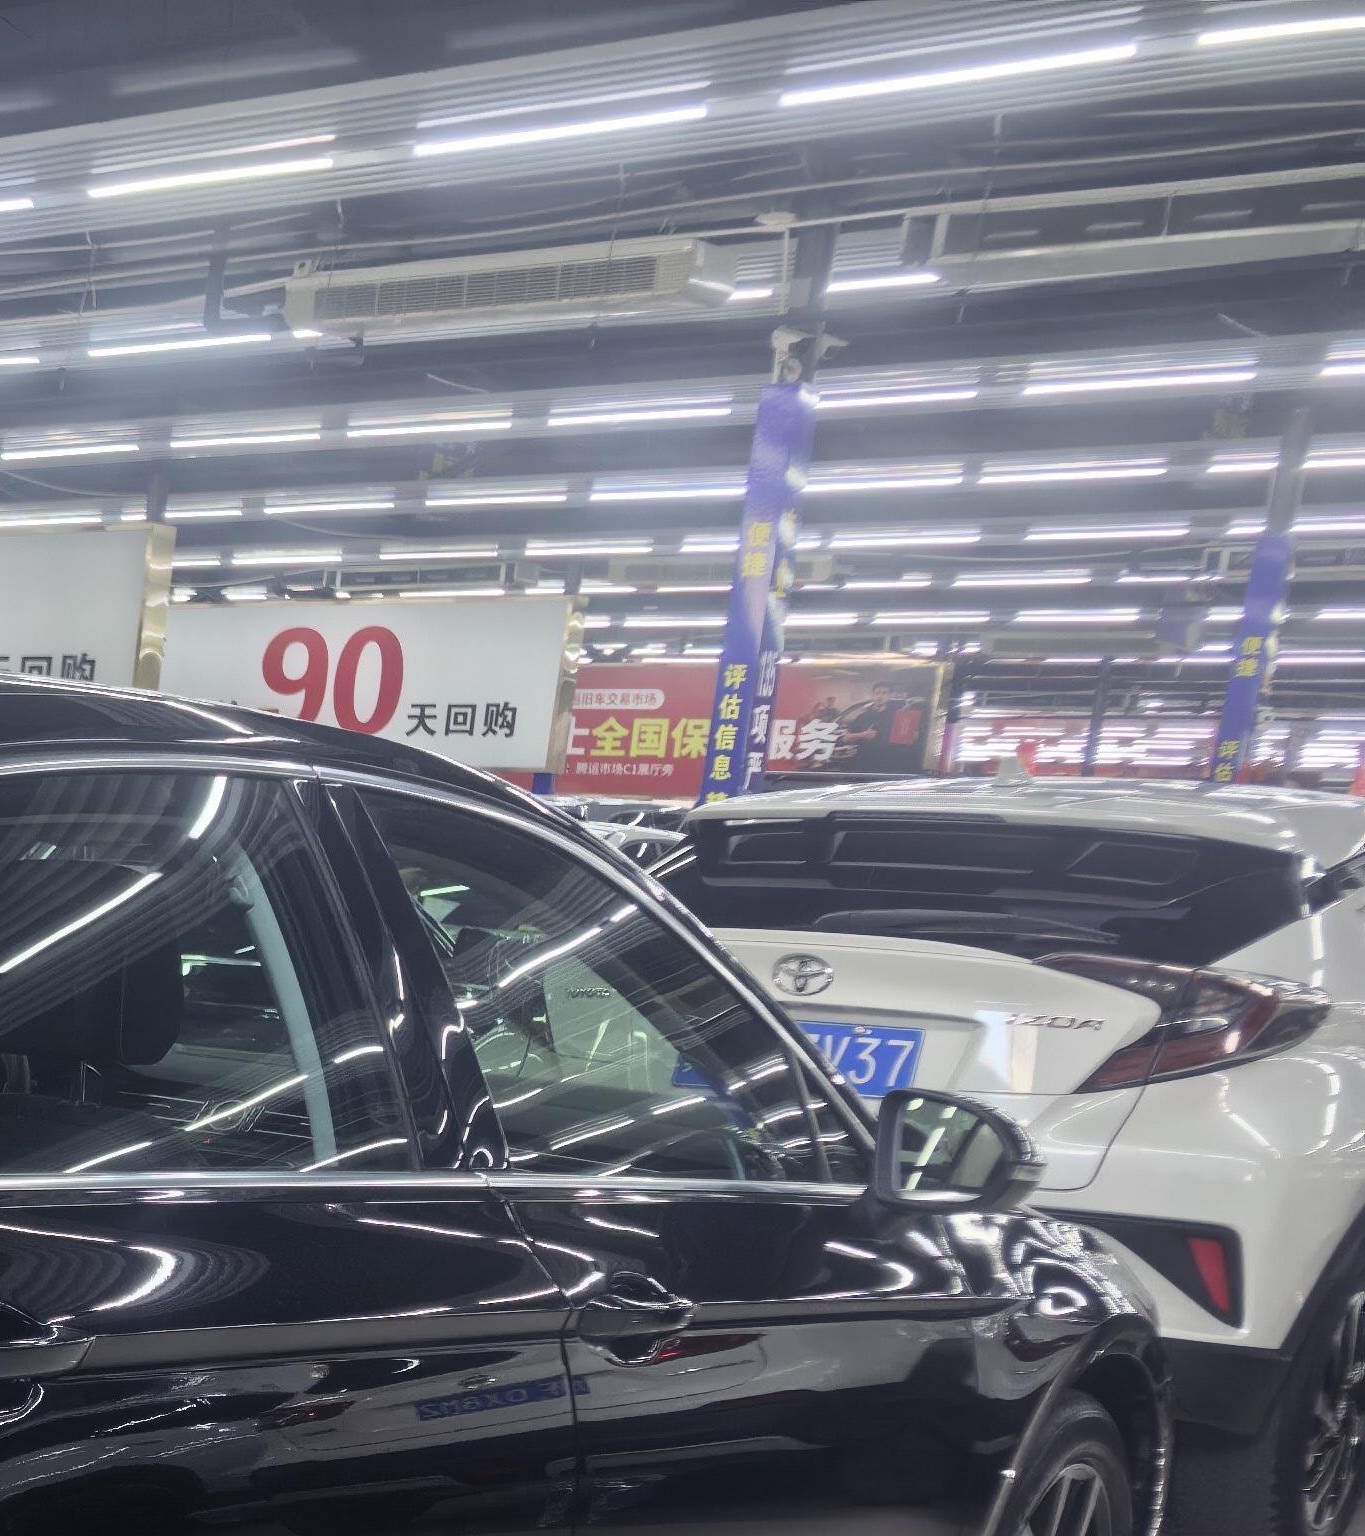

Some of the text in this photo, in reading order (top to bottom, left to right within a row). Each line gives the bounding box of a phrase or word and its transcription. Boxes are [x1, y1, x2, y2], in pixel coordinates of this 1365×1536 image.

[261, 625, 405, 735] 90
[404, 700, 519, 739] 天回购
[706, 663, 748, 803] 评估信息
[803, 1033, 916, 1088] V37
